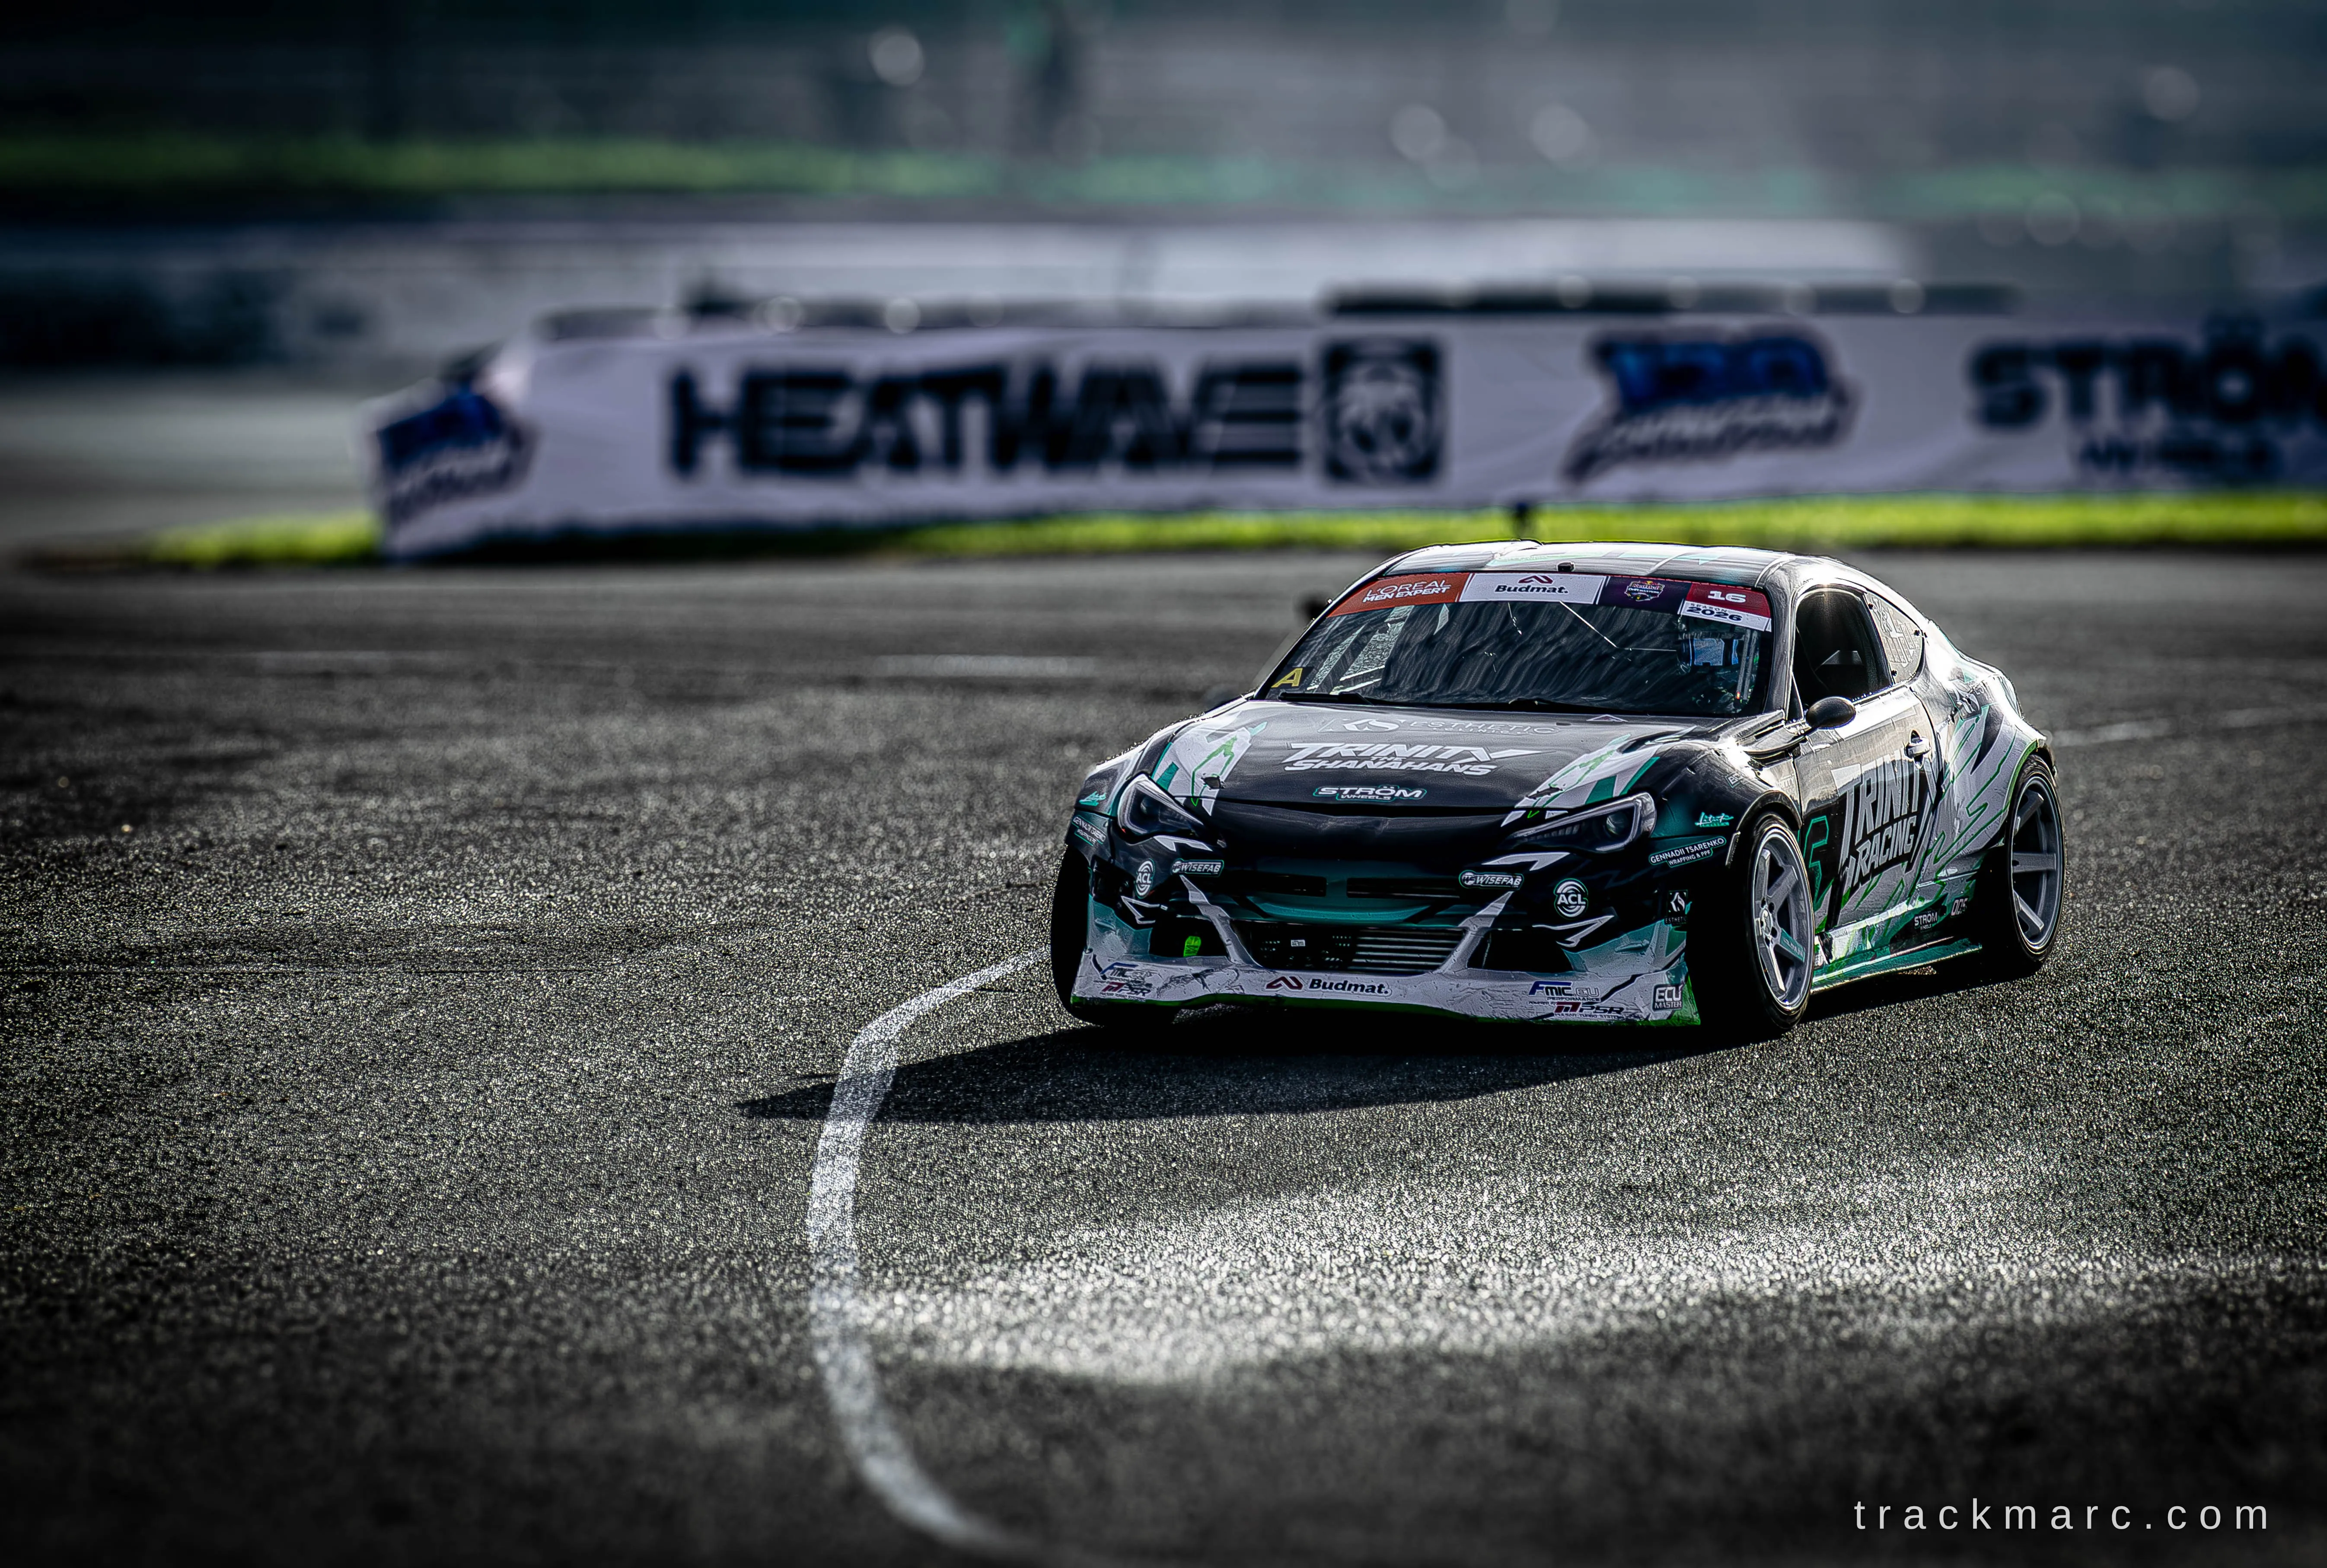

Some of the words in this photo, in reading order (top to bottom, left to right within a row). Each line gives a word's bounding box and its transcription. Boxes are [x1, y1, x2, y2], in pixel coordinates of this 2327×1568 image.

[668, 360, 1302, 482] HEATWAVE
[1362, 593, 1393, 602] MEN
[1395, 587, 1450, 598] EXPERT
[1495, 585, 1568, 594] Budmat.
[1708, 591, 1746, 603] 16
[1686, 606, 1743, 621] 2026
[1271, 668, 1303, 688] A
[1410, 721, 1557, 734] ESTHETIC
[1281, 743, 1543, 764] TRINITY
[1284, 759, 1497, 776] SHANAHANS
[1318, 786, 1422, 798] STRÖM
[1831, 748, 1939, 874] TRINITY
[1685, 838, 1725, 853] TSARENKO
[1853, 815, 1917, 887] RACING
[1668, 854, 1696, 866] WRAPPING
[1181, 864, 1221, 873] WISEFAB
[1136, 873, 1152, 884] ACL
[1476, 875, 1522, 886] WISEFAB
[1557, 894, 1586, 905] ACL
[1914, 911, 1938, 927] STRÖM
[1309, 978, 1389, 994] Budmat.
[1655, 985, 1683, 1002] ECU
[1579, 1005, 1624, 1014] PSR
